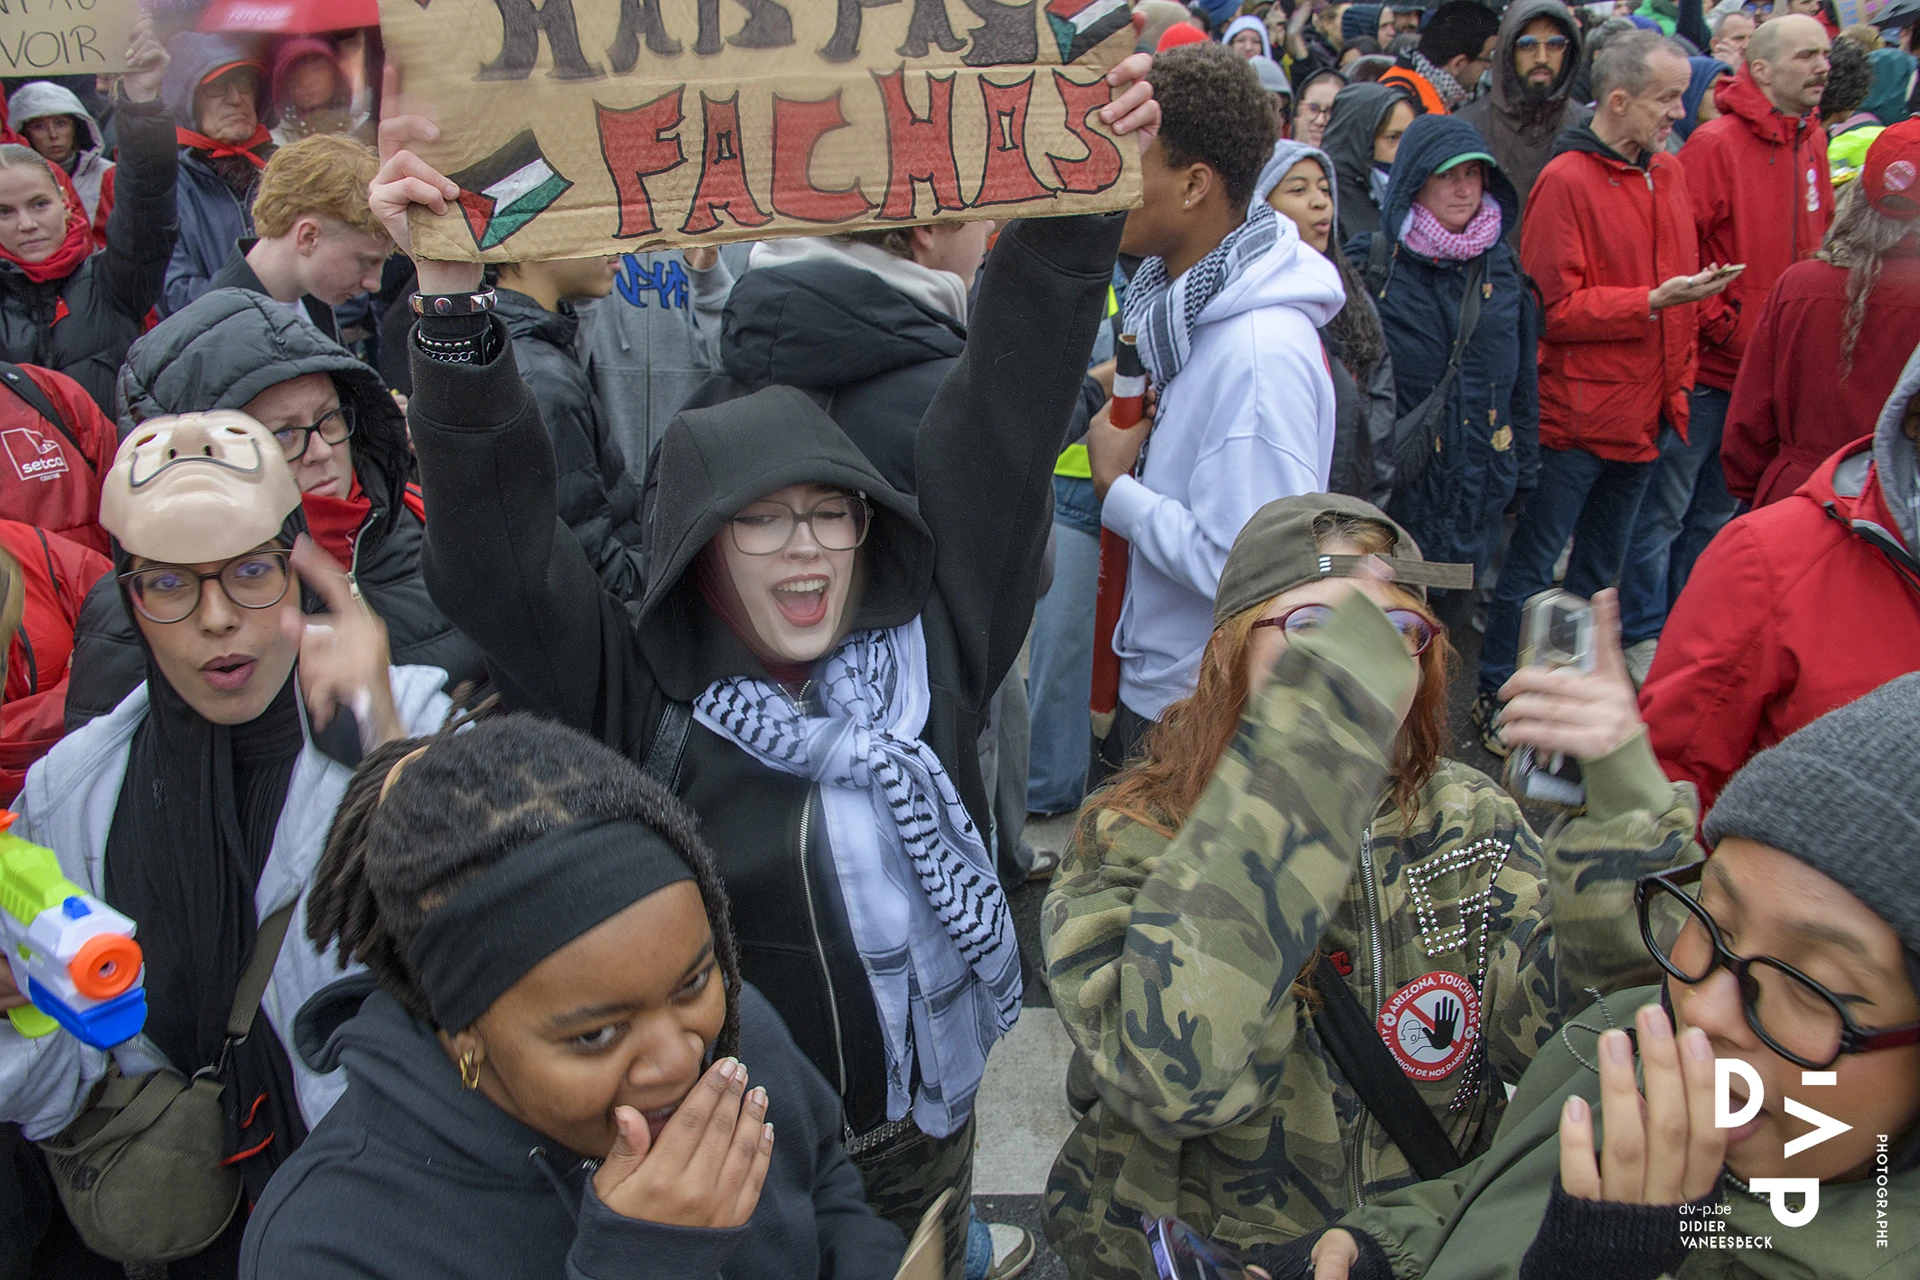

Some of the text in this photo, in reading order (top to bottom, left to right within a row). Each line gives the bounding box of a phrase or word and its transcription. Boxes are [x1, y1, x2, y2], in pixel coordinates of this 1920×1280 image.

[593, 61, 1124, 239] FACHOS
[22, 456, 65, 473] setca
[1388, 974, 1477, 1024] ARIZONA, TOUCHE PAS
[1415, 1068, 1428, 1077] DE
[1429, 1067, 1447, 1077] NOS
[1446, 1041, 1470, 1071] DARONS
